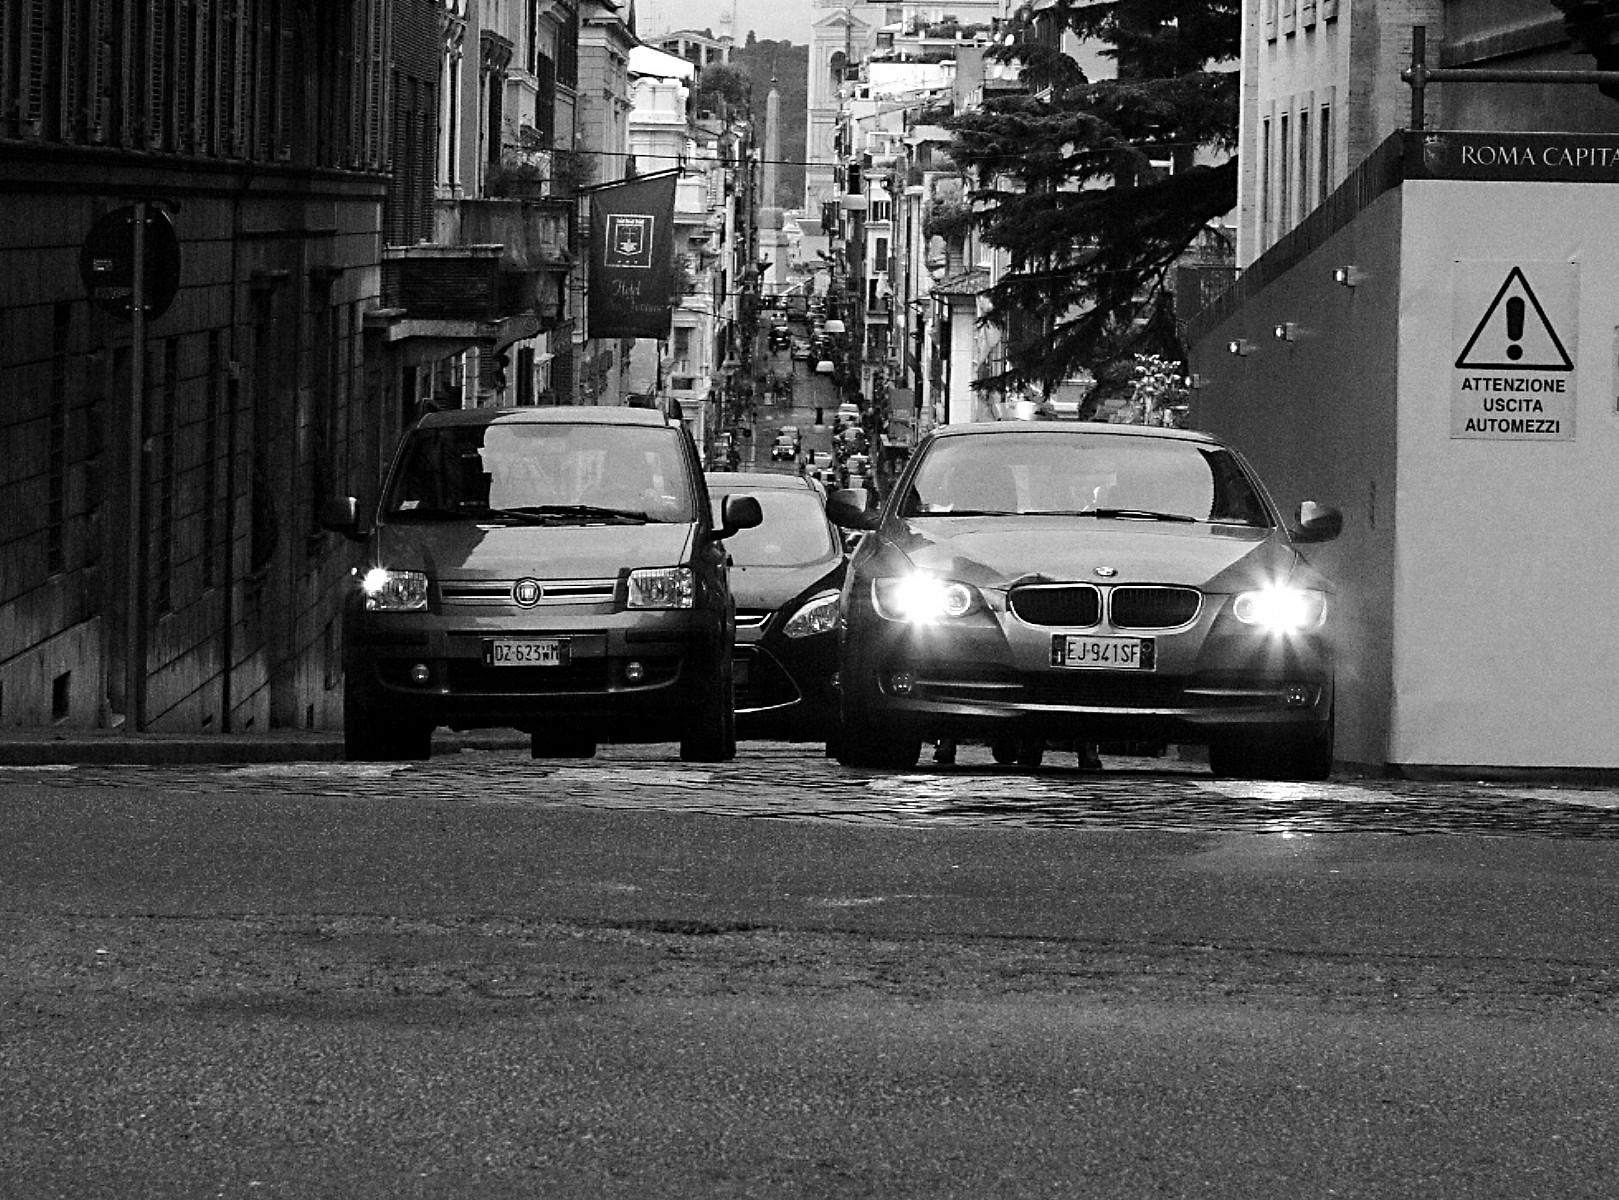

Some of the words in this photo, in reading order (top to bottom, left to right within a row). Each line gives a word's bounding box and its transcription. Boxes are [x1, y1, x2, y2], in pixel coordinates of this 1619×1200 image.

[1462, 146, 1535, 166] ROMA
[1543, 146, 1619, 167] CAPITA
[1461, 377, 1566, 393] ATTENZIONE
[1483, 398, 1543, 412] USCITA
[1465, 418, 1560, 433] AUTOMEZZI
